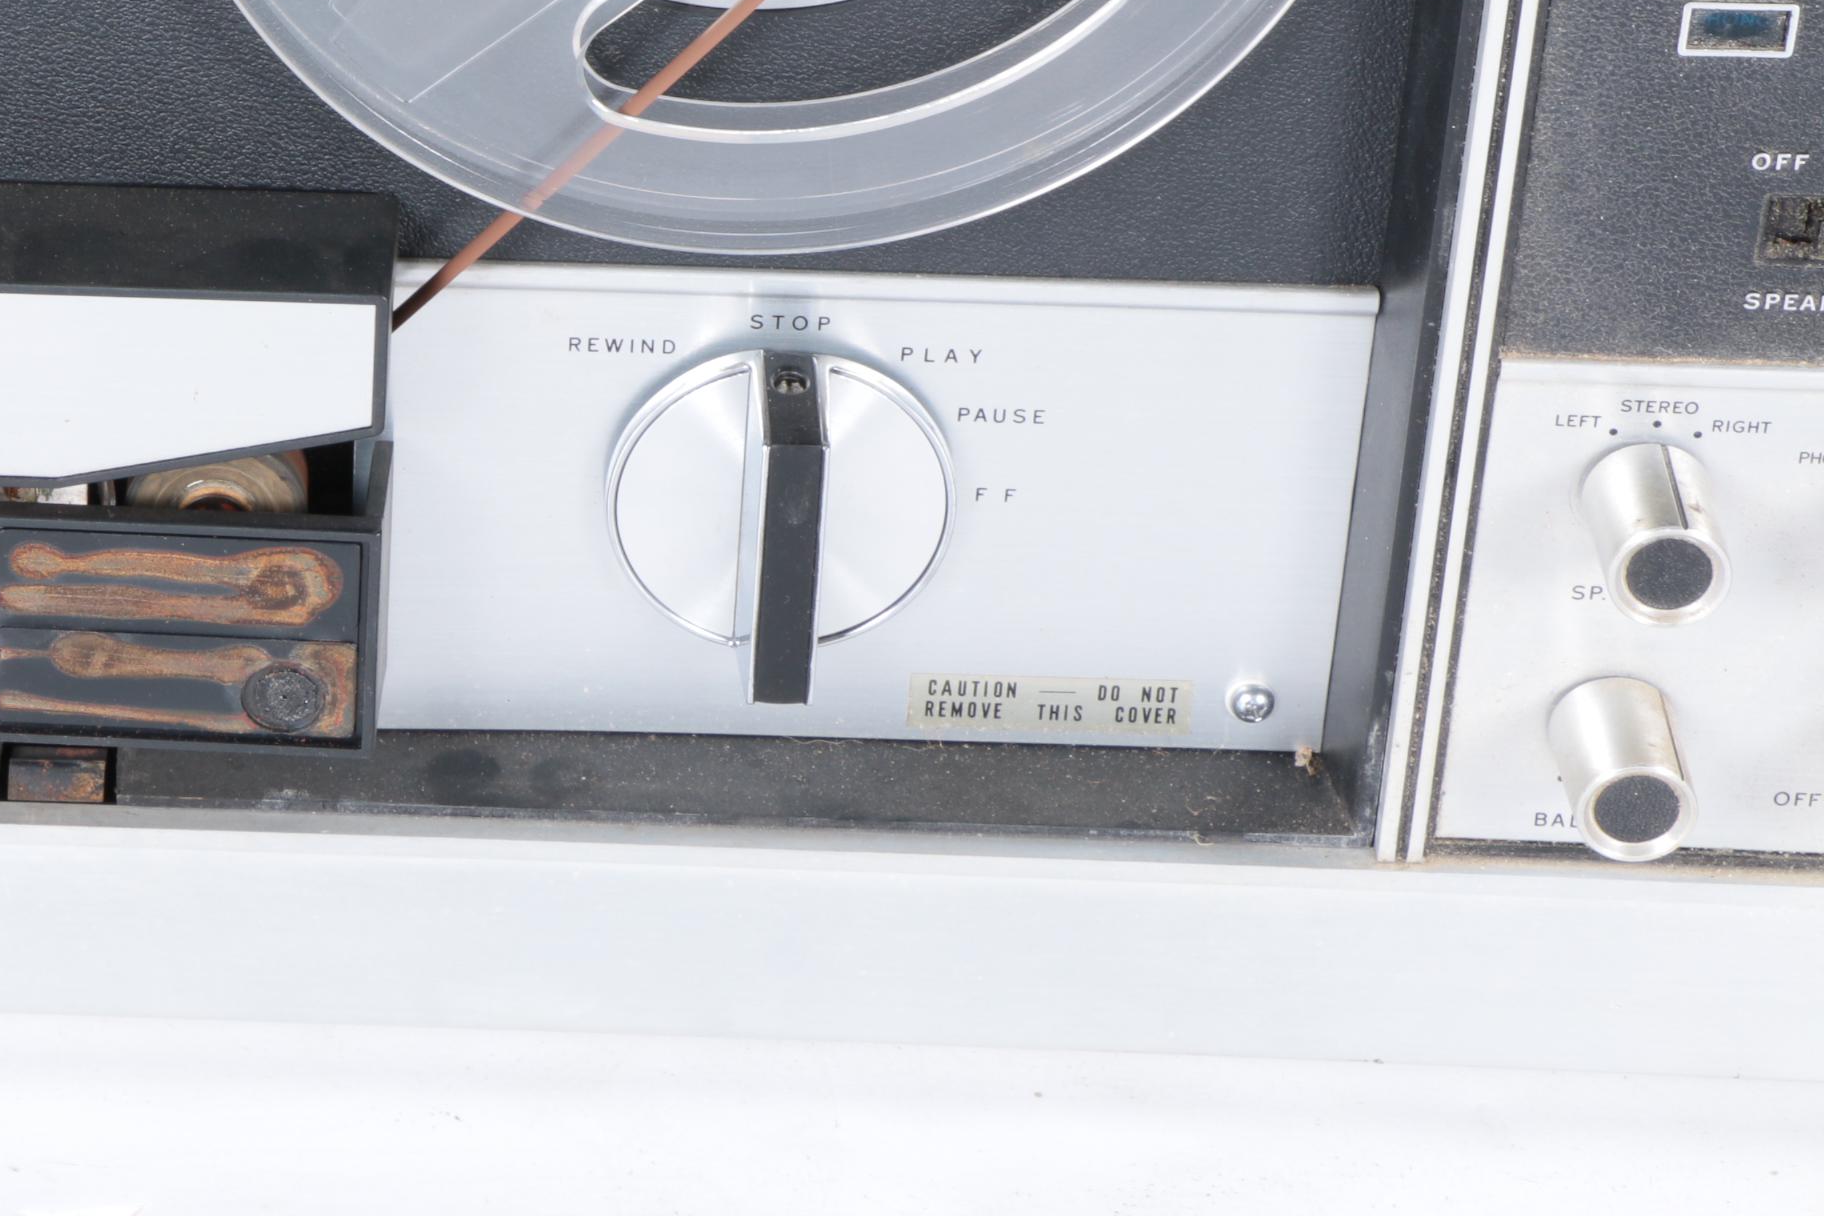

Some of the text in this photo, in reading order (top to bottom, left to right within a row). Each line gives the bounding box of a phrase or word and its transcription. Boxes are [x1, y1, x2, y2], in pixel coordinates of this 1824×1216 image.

[1751, 152, 1810, 172] OFF
[750, 314, 832, 332] STOP
[568, 337, 678, 356] REWIND
[900, 347, 985, 365] PLAY
[1620, 399, 1700, 415] STEREO
[957, 407, 1046, 426] PAUSE
[1555, 414, 1602, 429] LEFT
[1712, 419, 1772, 434] RIGHT
[1798, 451, 1824, 465] PH
[927, 679, 1018, 698] CAUTION
[1098, 684, 1121, 702] DO
[1141, 686, 1179, 704] NOT
[925, 701, 1177, 725] REMOVE THIS COVER
[1773, 791, 1822, 807] OFF
